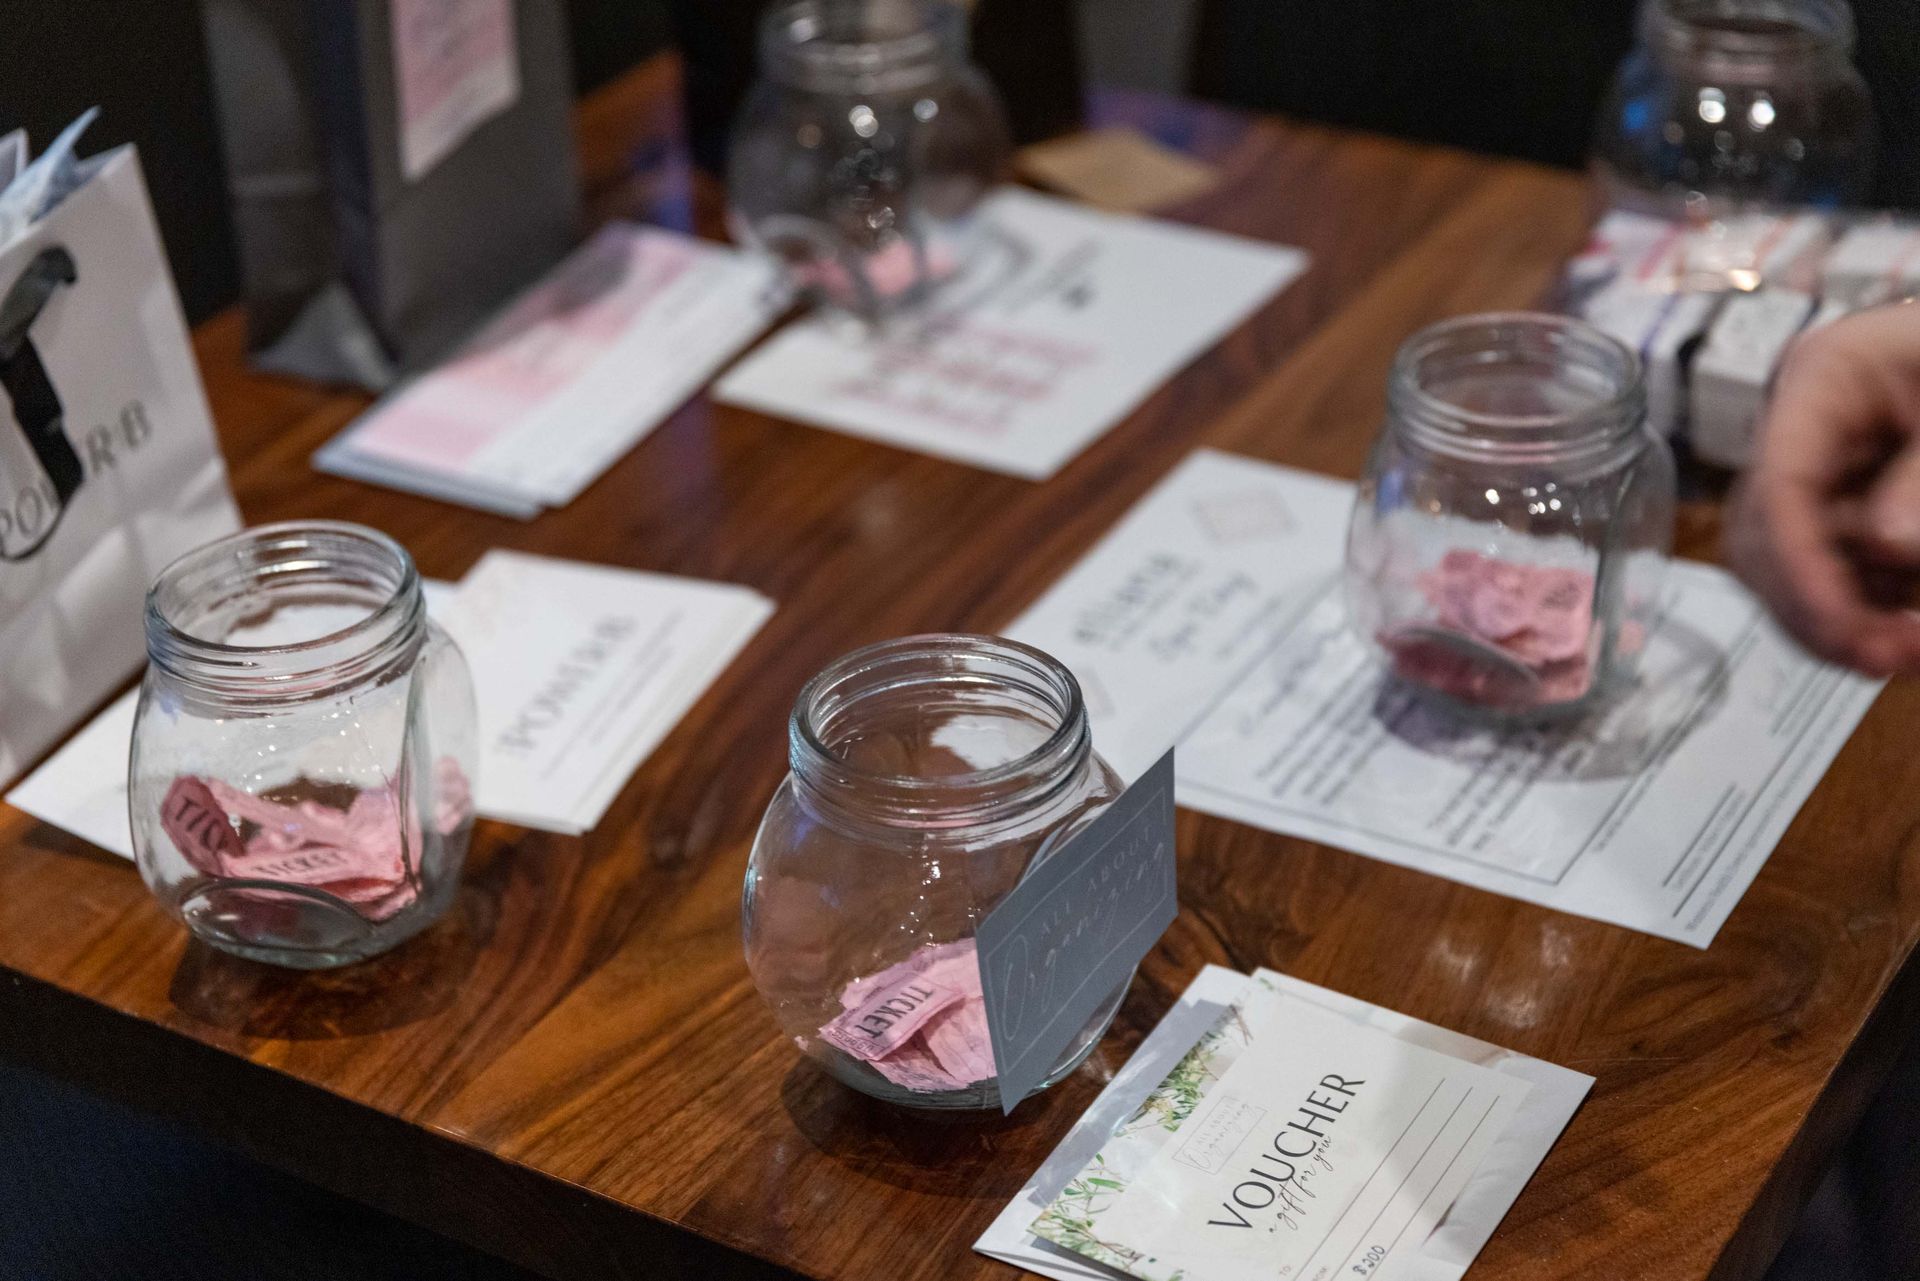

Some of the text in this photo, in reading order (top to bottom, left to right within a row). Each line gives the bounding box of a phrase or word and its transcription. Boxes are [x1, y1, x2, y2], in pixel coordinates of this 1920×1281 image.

[1041, 824, 1152, 940] ALL ABOUT
[855, 986, 935, 1039] TICKET
[1207, 1073, 1366, 1229] VOUCHER
[1313, 1135, 1334, 1172] you
[1276, 1179, 1306, 1231] gift
[1290, 1164, 1317, 1199] for
[1352, 1244, 1386, 1276] $200
